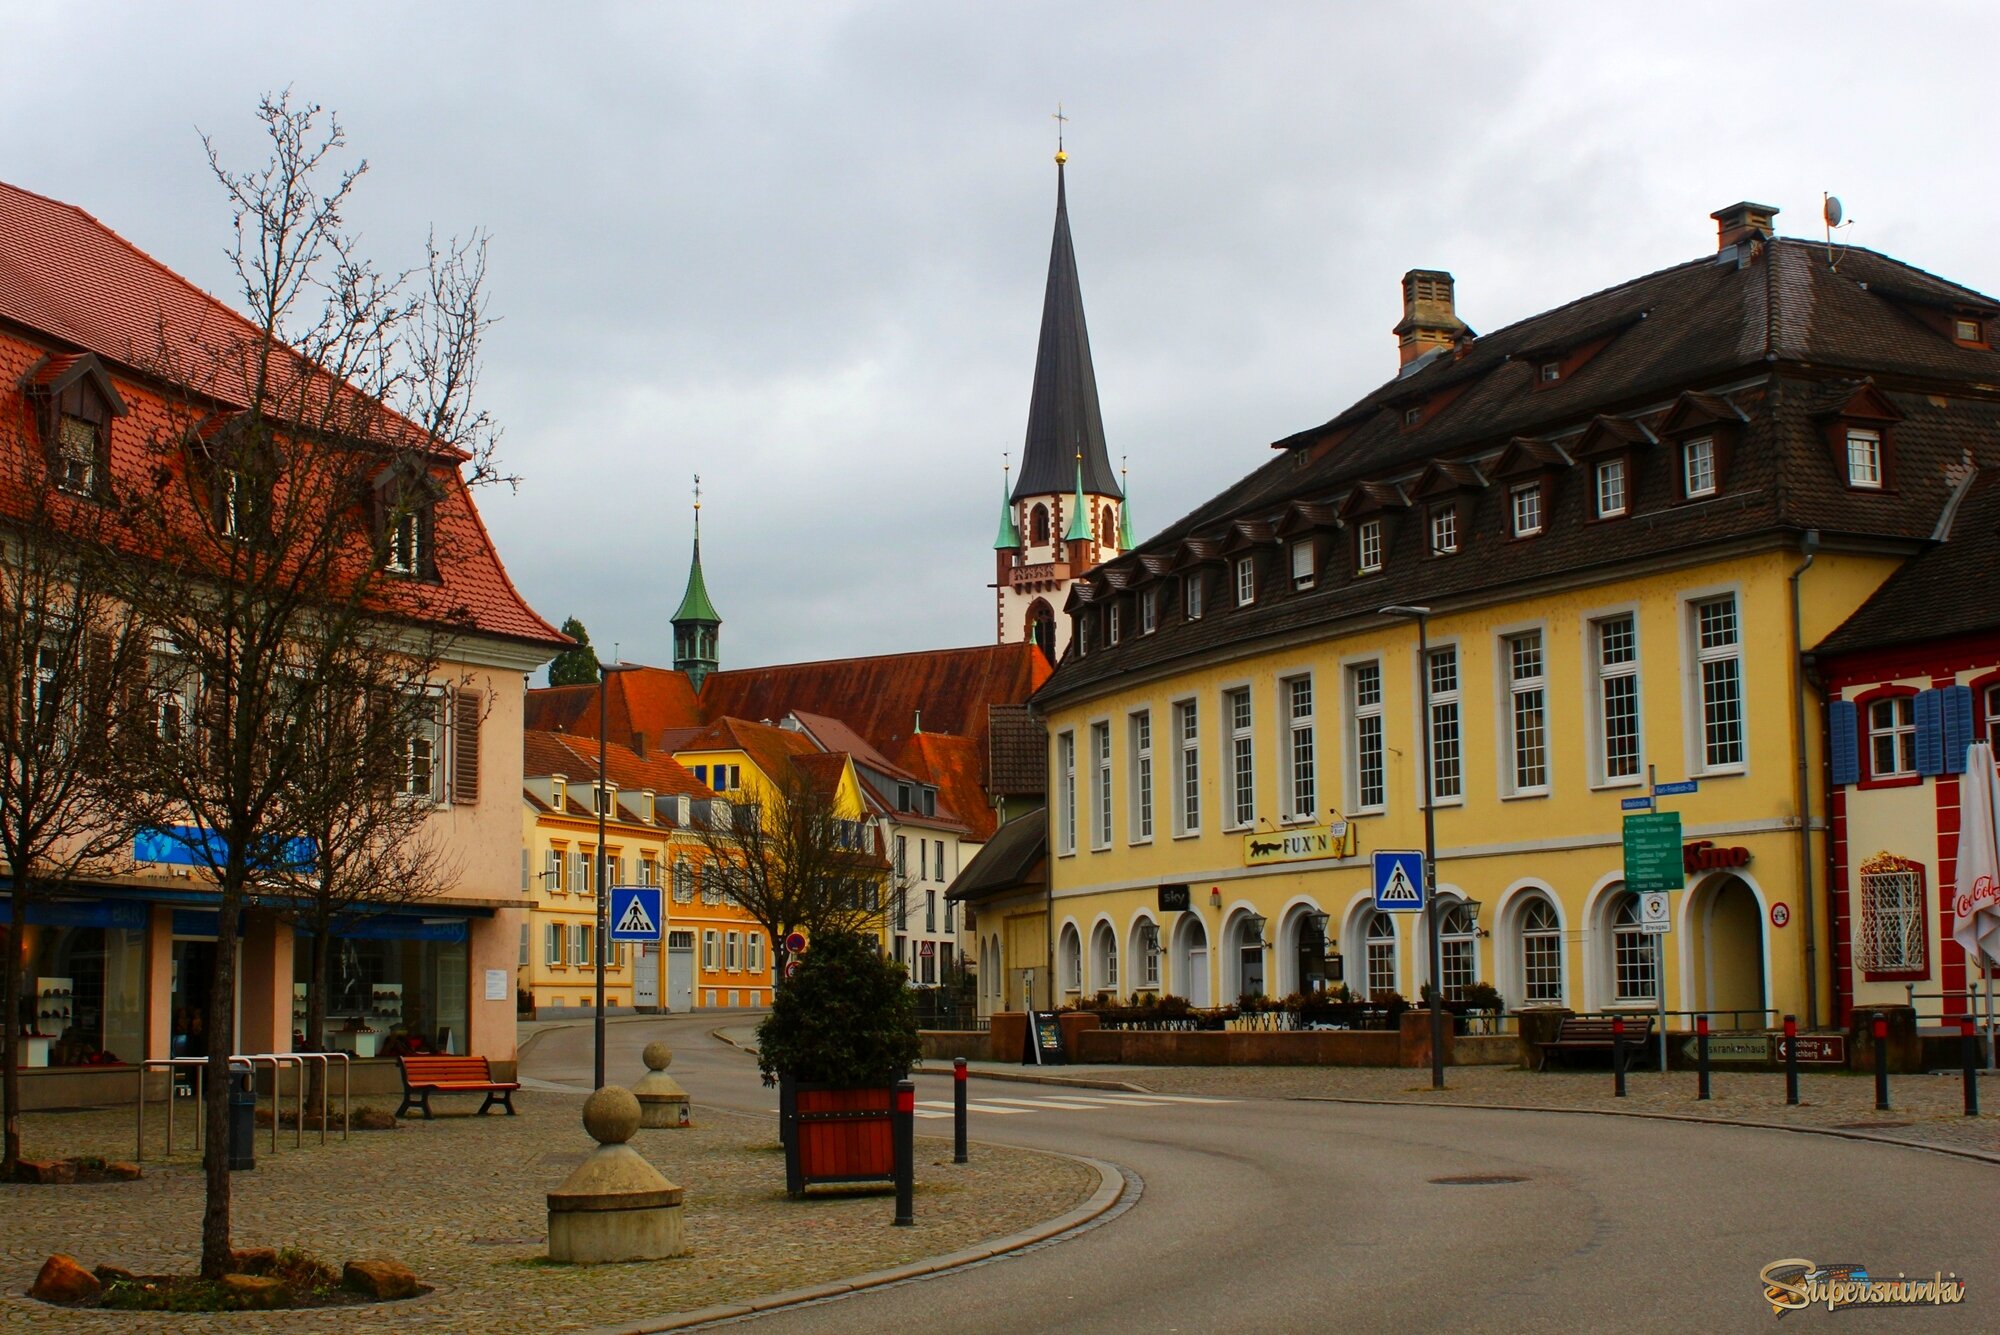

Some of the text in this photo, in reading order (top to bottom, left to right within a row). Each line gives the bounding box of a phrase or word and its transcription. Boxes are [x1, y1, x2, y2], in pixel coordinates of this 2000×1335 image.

[1682, 841, 1750, 874] Kino
[1163, 890, 1185, 905] sky
[112, 905, 141, 922] BAR
[1795, 1039, 1821, 1050] chburg-
